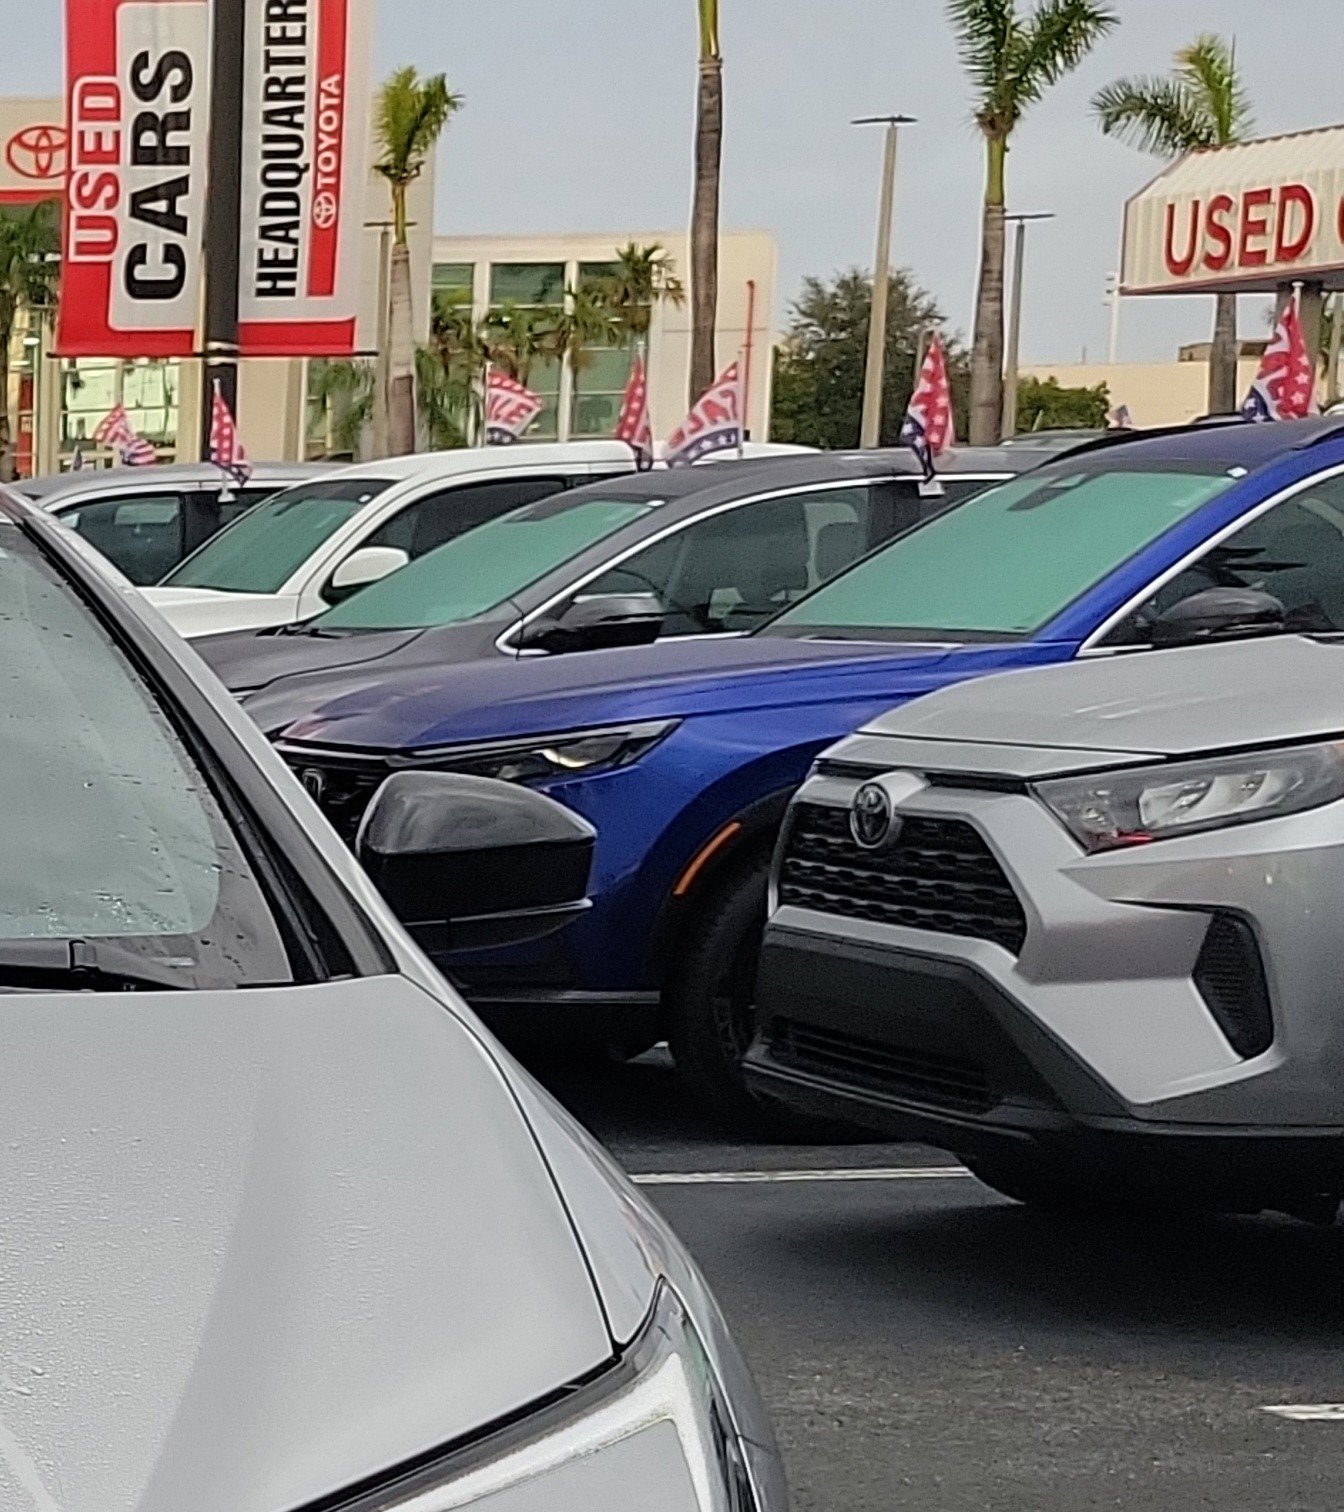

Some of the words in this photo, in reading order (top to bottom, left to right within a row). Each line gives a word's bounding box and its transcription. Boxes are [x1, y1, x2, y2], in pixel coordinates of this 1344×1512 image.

[70, 76, 121, 263] USED
[124, 50, 193, 300] CARS
[255, 0, 310, 298] HEADQUARTER
[316, 74, 341, 189] TOYOTA
[1164, 184, 1314, 276] USED
